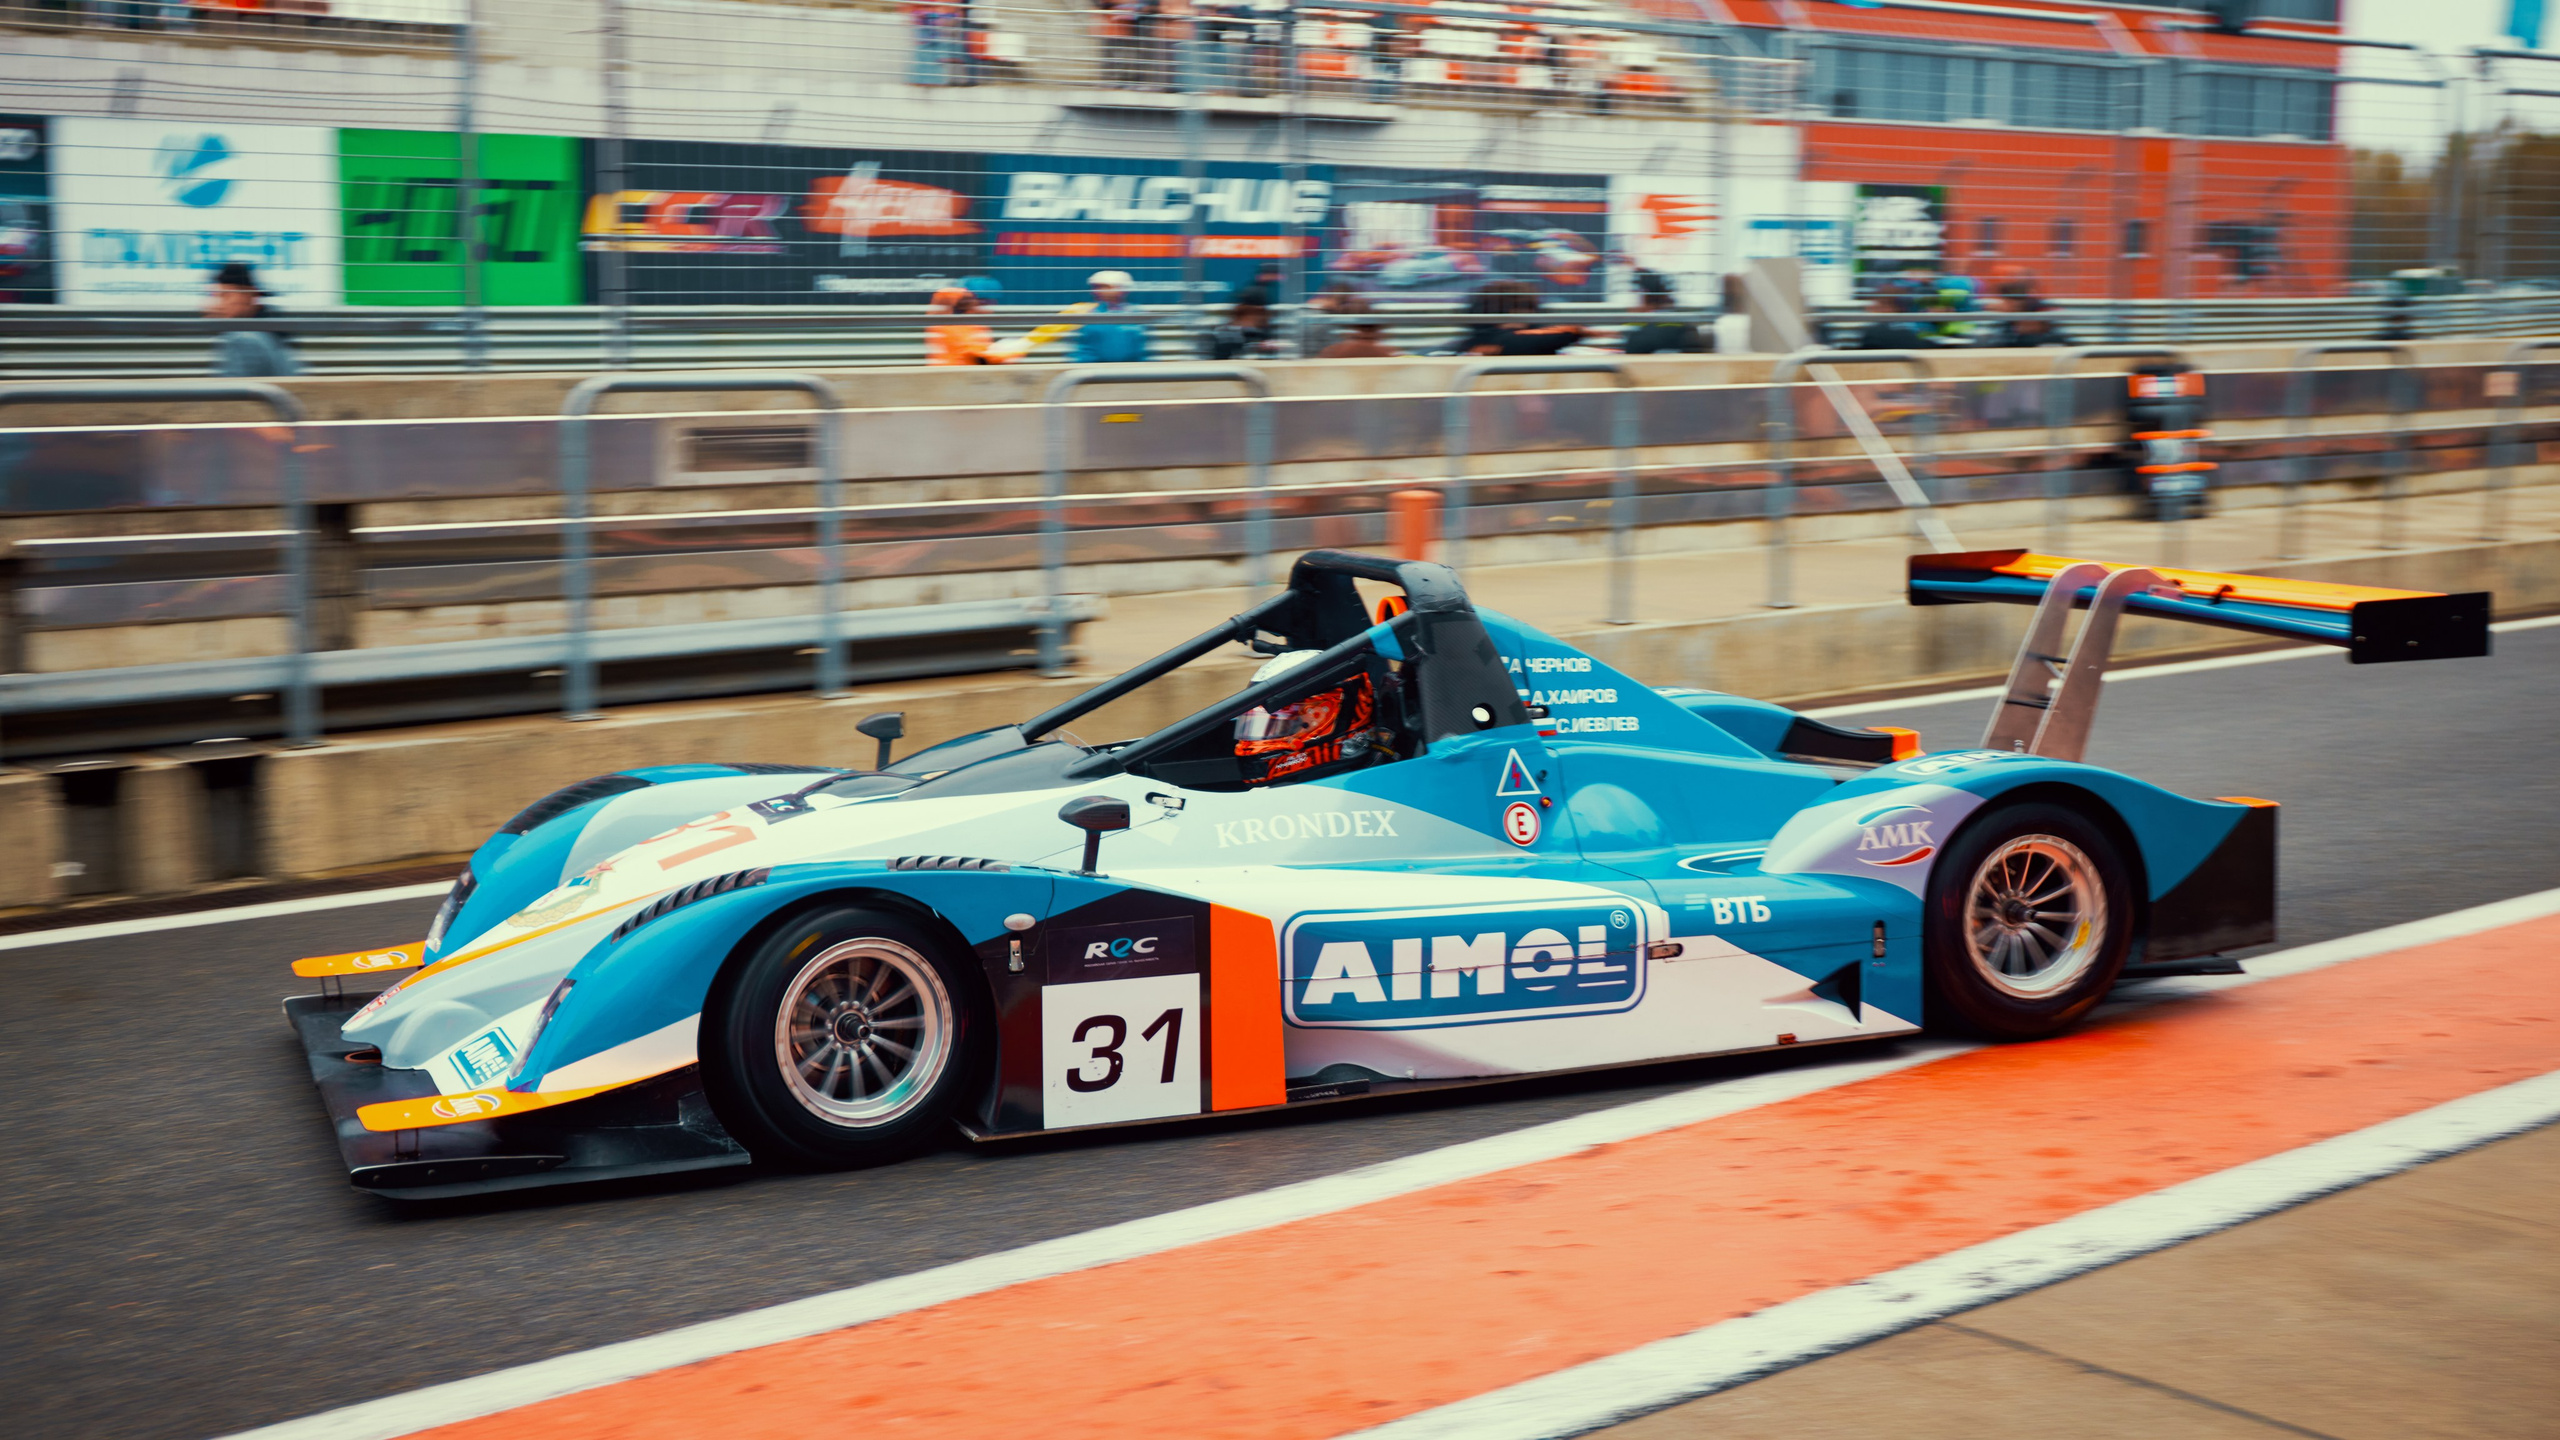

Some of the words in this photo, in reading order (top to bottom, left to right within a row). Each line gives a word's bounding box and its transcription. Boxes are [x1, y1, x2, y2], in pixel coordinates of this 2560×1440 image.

[1213, 810, 1399, 849] KRONDEX
[1515, 811, 1529, 836] E
[1710, 895, 1772, 926] ВТБ
[1301, 924, 1628, 1006] AIMOL
[1066, 1007, 1184, 1093] 31
